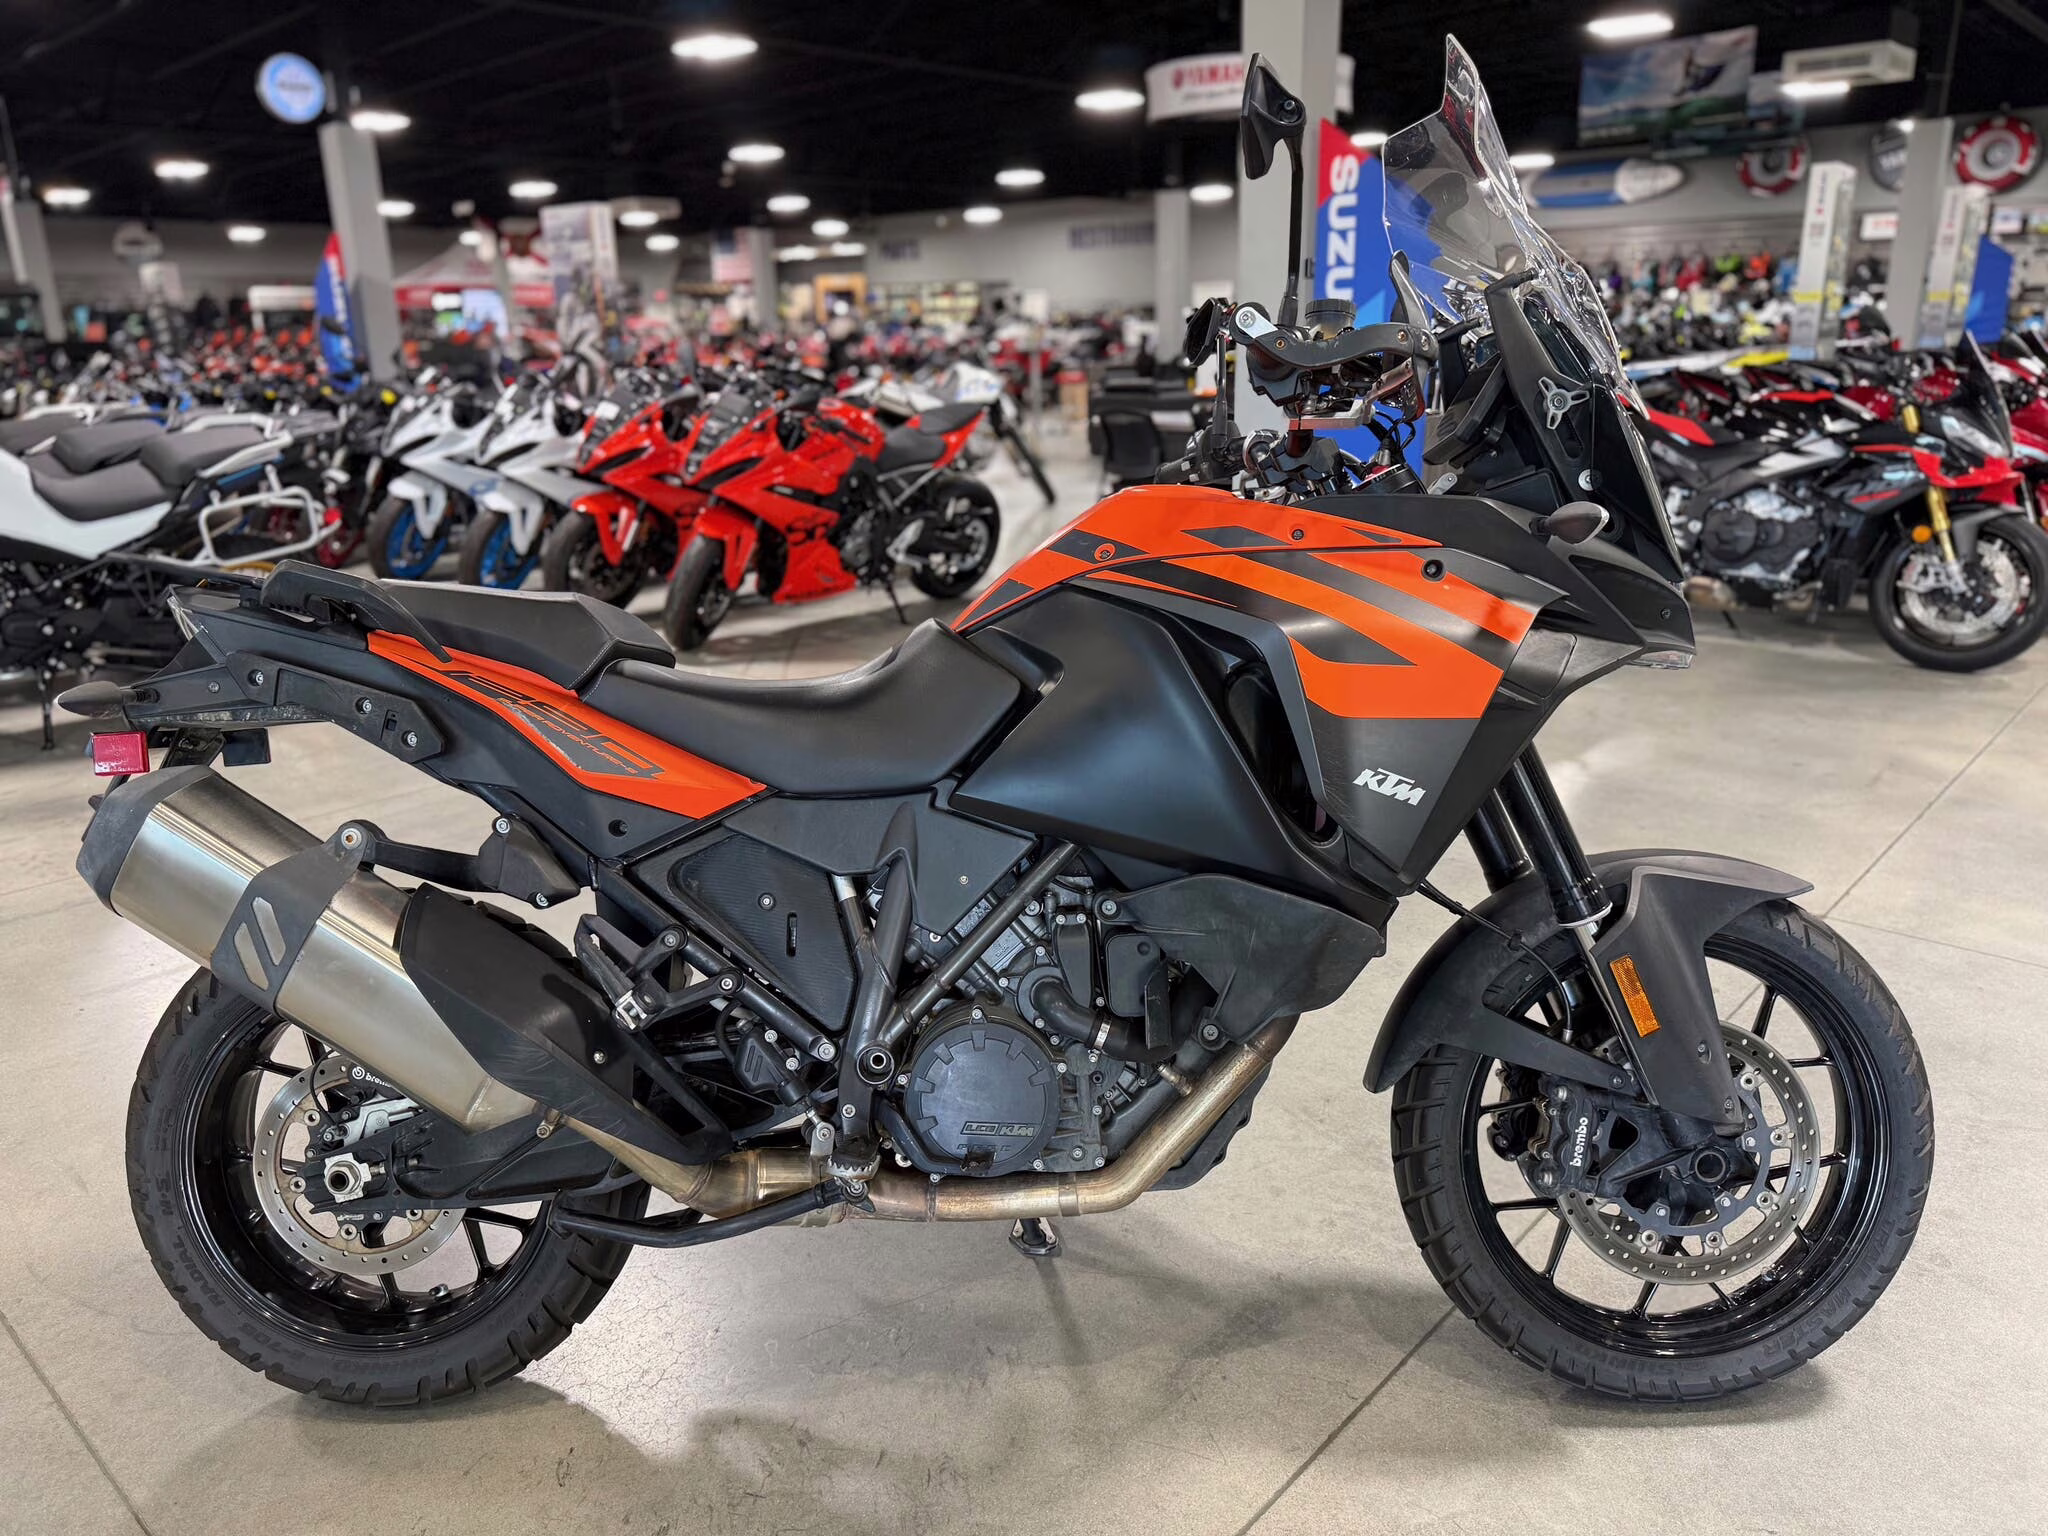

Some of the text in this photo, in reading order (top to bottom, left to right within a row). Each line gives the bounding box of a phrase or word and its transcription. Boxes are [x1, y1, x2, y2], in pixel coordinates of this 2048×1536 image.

[1352, 767, 1426, 806] KTM
[1000, 1122, 1034, 1136] KTM
[1569, 1117, 1588, 1167] brembo
